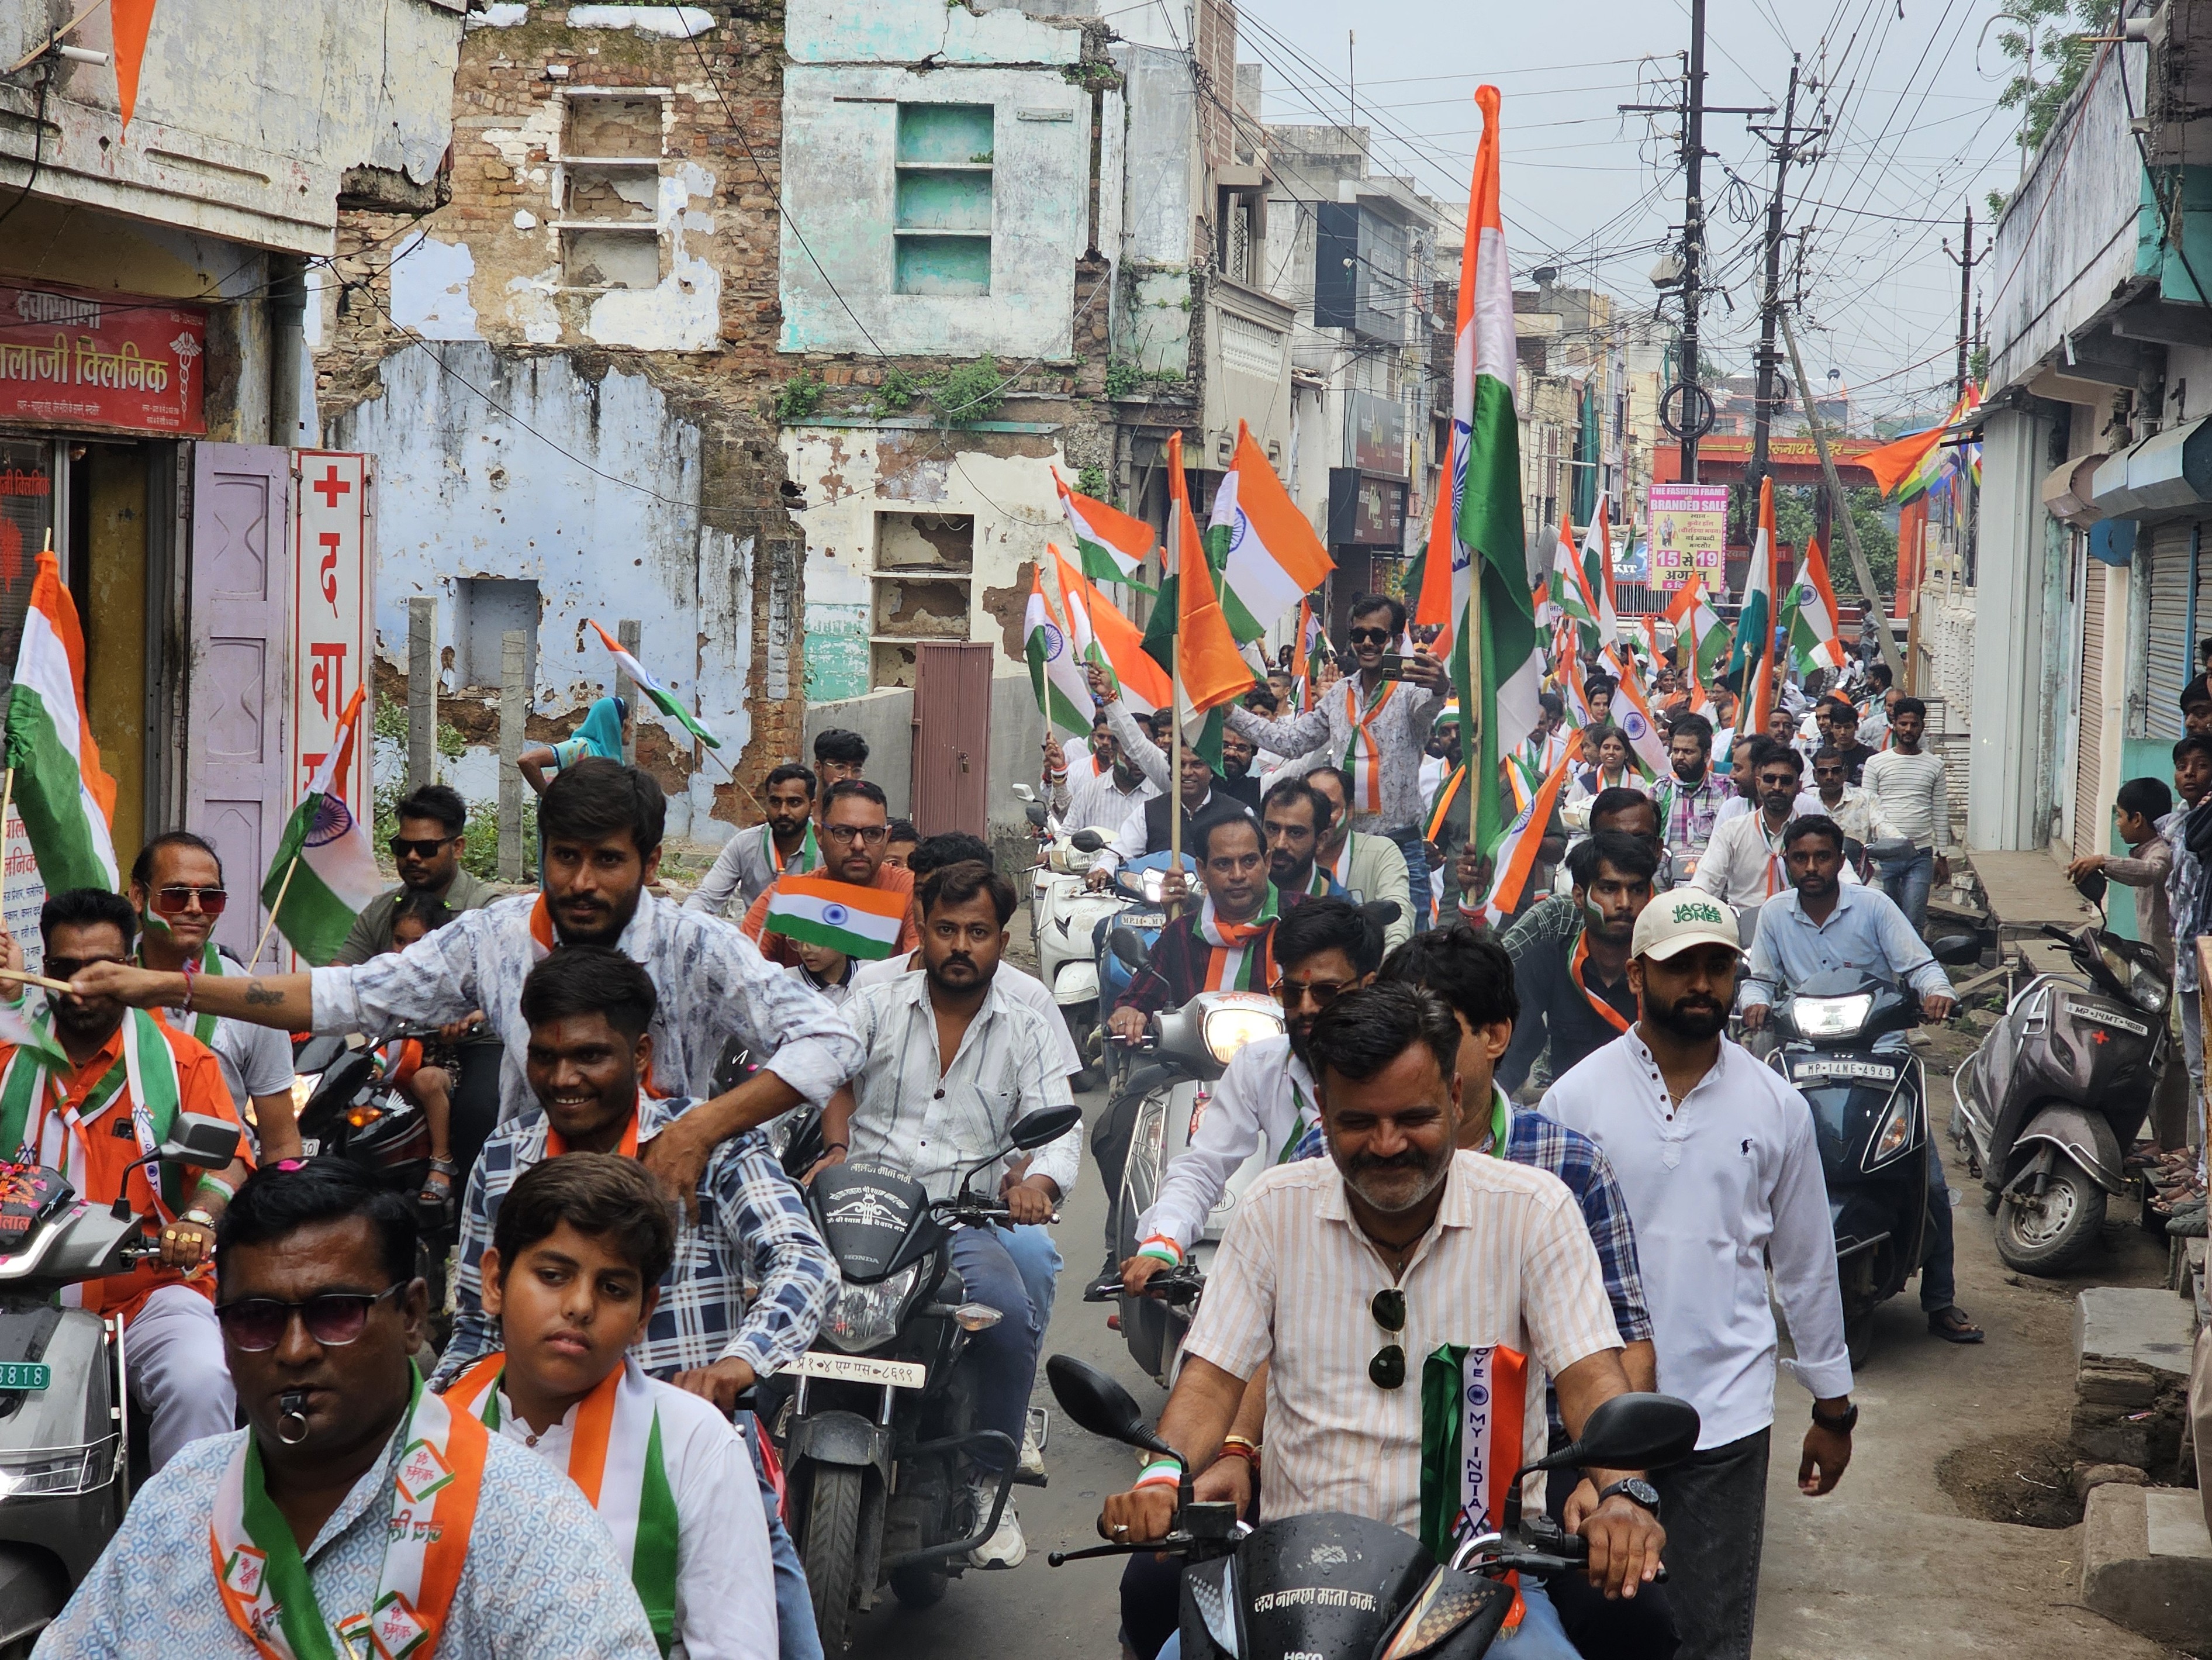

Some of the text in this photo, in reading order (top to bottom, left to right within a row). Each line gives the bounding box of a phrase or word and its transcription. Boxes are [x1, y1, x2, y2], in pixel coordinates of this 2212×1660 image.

[1667, 487, 1699, 496] FASHION
[1701, 488, 1726, 496] FRAME
[1650, 499, 1727, 512] BRANDED SALE
[1657, 551, 1678, 566] 15
[1682, 552, 1694, 567] से
[1697, 551, 1717, 567] 19
[1673, 910, 1723, 924] JONES
[844, 1254, 880, 1264] HONDA
[1473, 1347, 1490, 1378] OVE
[1470, 1411, 1486, 1438] MY
[1467, 1447, 1484, 1509] INDIA
